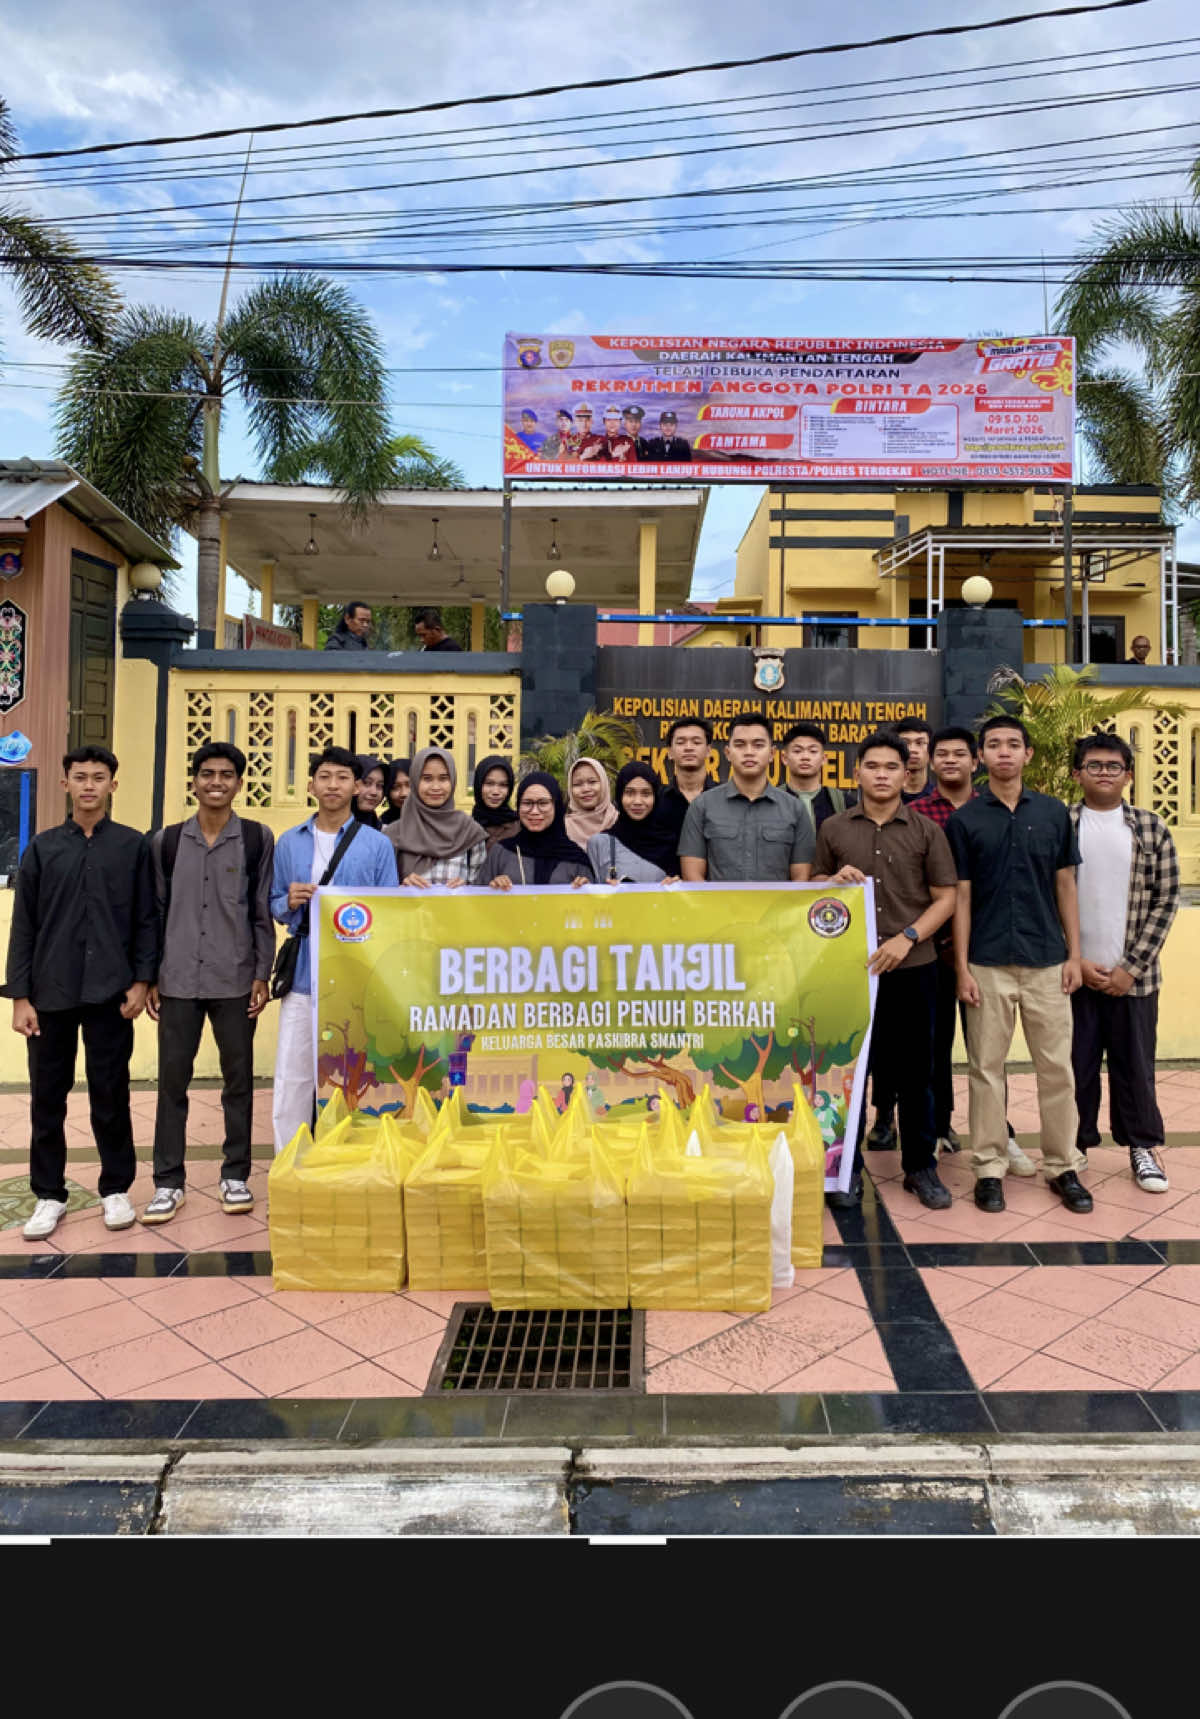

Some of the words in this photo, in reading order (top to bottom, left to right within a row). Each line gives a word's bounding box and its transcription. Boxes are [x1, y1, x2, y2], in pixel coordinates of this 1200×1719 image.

[609, 338, 702, 348] KEPOLISIAN
[707, 339, 773, 349] NEGARA
[775, 340, 850, 350] REPUBLIK
[856, 340, 945, 350] INDONESIA
[659, 352, 721, 361] DAERAH
[726, 352, 829, 363] KALIMANTAN
[832, 353, 894, 363] TENGAH
[988, 353, 1057, 371] GRATIS
[654, 366, 704, 377] TELAH
[710, 367, 774, 377] DIBUKA
[779, 367, 900, 379] PENDAFTARAN
[571, 379, 702, 393] REKRUTMEN
[709, 380, 819, 395] ANGGOTA
[826, 383, 892, 395] POLRI
[937, 383, 988, 395] 2026
[710, 406, 750, 419] TARUNA
[752, 406, 785, 419] AKPOL
[855, 399, 908, 413] BINTARA
[987, 414, 1001, 424] 09
[984, 425, 1015, 435] Maret
[1017, 425, 1044, 435] 2026
[710, 435, 767, 448] TAMTAMA
[525, 462, 562, 473] UNTUK
[564, 463, 625, 474] INFORMASI
[627, 464, 658, 474] LEBIH
[660, 464, 698, 475] LANJUT
[858, 466, 912, 476] TERDEKAT
[921, 466, 968, 476] HOTLINE
[613, 697, 699, 717] KEPOLISIAN
[703, 698, 762, 719] DAERAH
[766, 699, 861, 720] KALIMANTAN
[866, 702, 927, 721] TENGAH
[829, 723, 878, 743] BARAT
[439, 945, 598, 995] BERBAGI
[610, 943, 746, 993] TAKJIL
[409, 1002, 517, 1032] RAMADAN
[524, 1001, 611, 1029] BERBAGI
[617, 1001, 686, 1028] PENUH
[692, 1000, 776, 1029] BERKAH
[481, 1034, 543, 1051] KELUARGA
[546, 1033, 585, 1050] BESAR
[588, 1032, 648, 1050] PASKIBRA
[651, 1032, 704, 1050] SMANTRI
